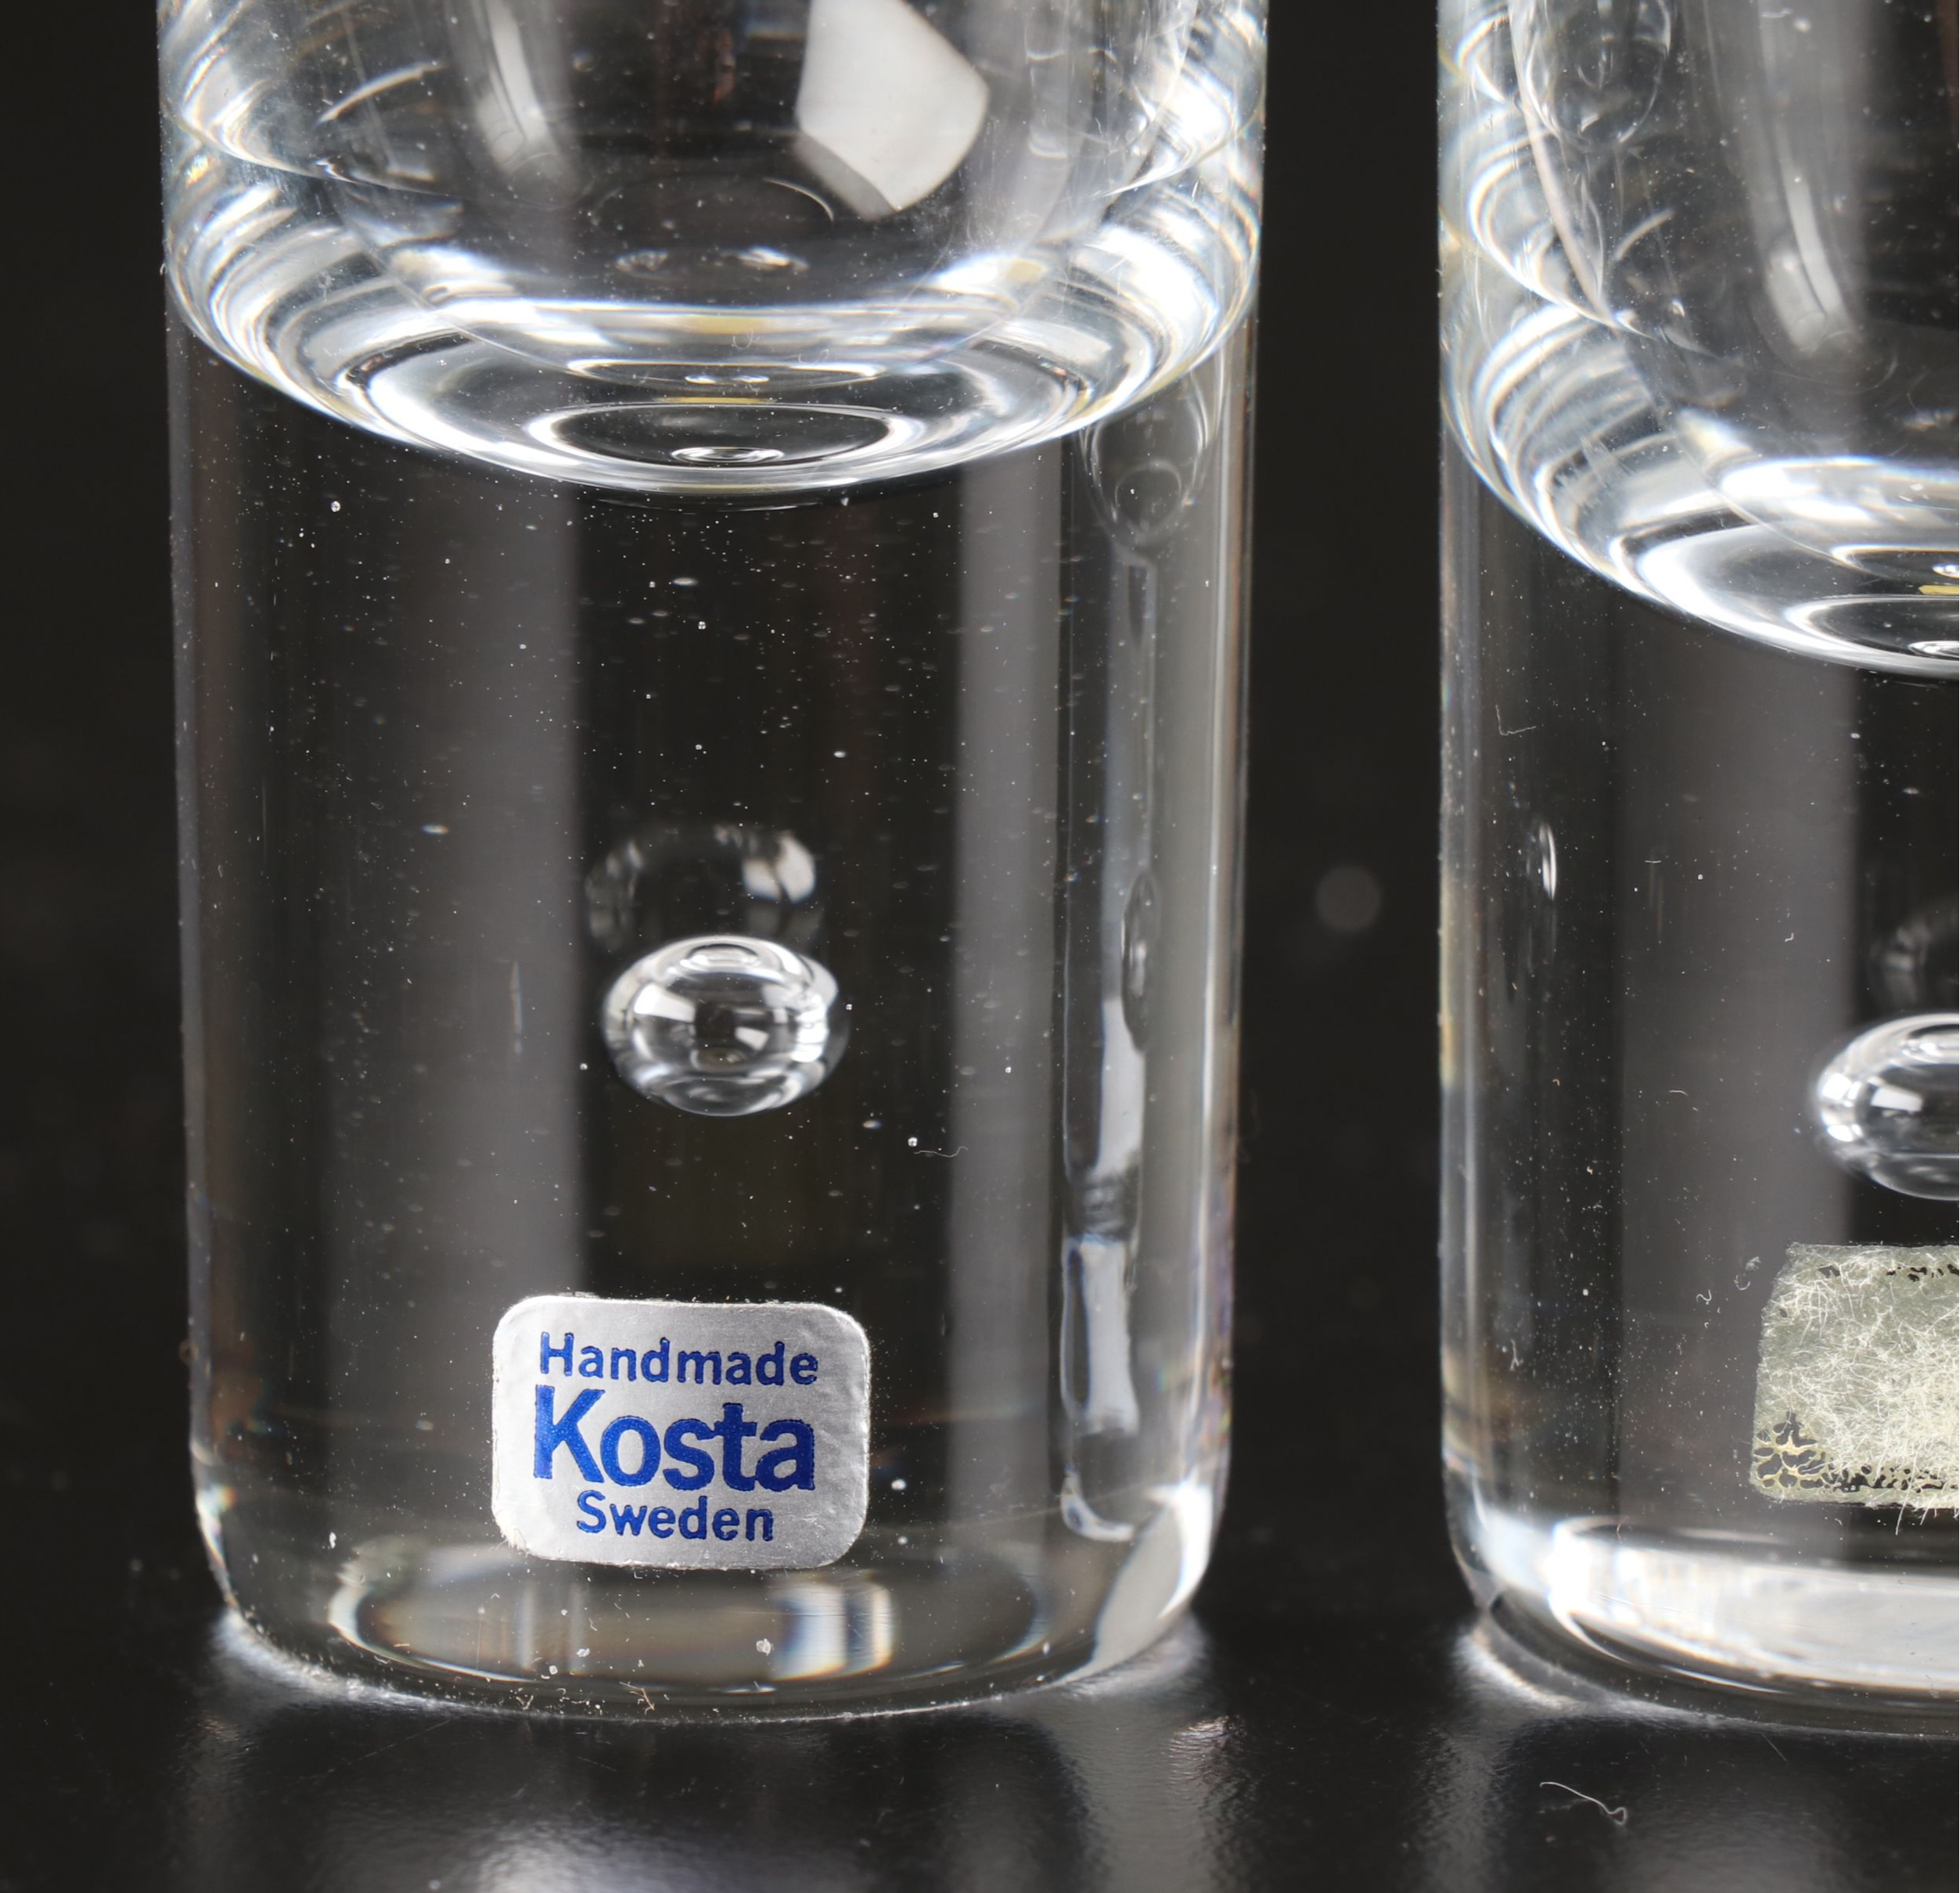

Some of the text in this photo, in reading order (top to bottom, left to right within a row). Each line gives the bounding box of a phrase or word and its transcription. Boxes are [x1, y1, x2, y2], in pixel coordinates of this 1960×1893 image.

[540, 1332, 818, 1385] Handmade
[534, 1385, 815, 1492] Kosta
[577, 1490, 774, 1541] Sweden
